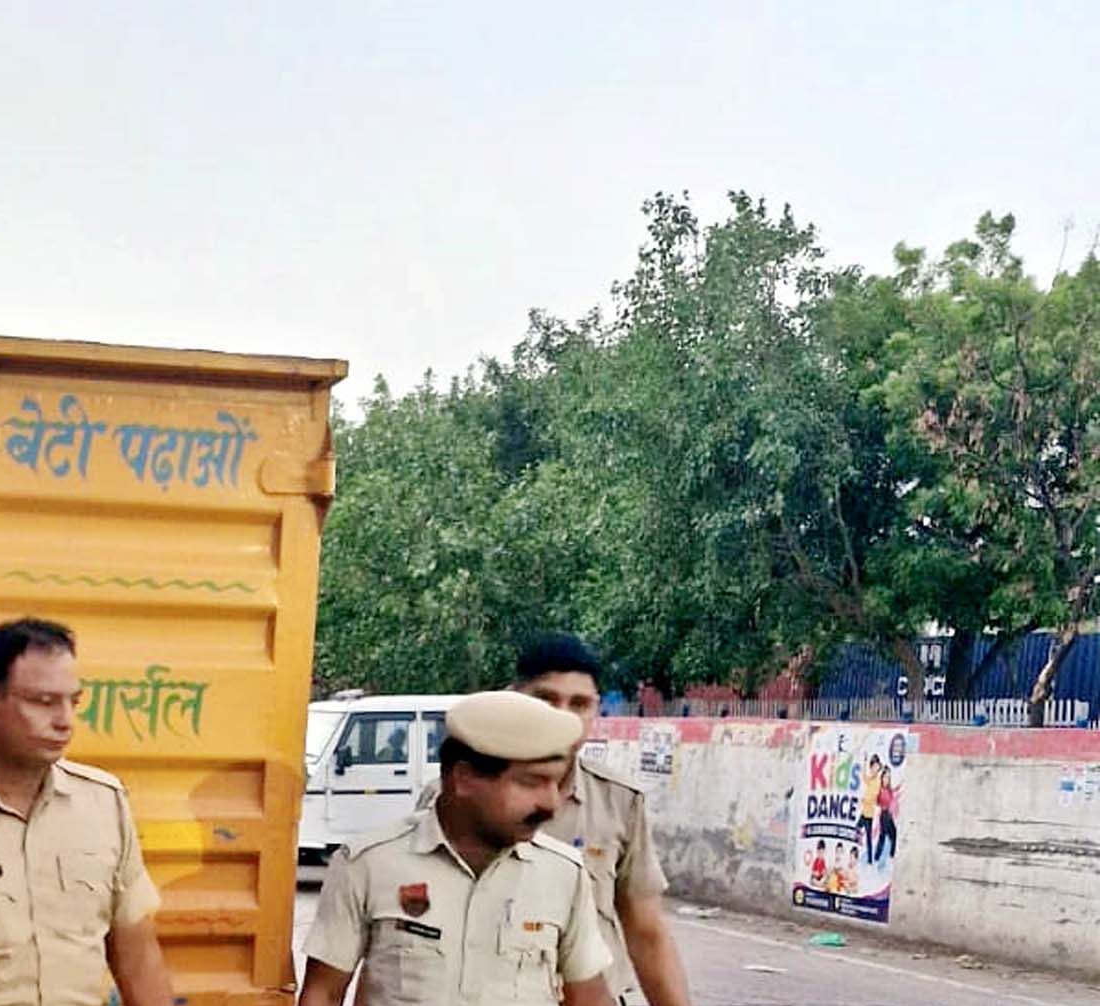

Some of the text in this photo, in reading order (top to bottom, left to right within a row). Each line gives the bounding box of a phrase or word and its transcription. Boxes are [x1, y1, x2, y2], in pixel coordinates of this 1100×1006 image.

[4, 394, 107, 479] बेटी
[810, 752, 860, 791] Kids
[807, 795, 859, 821] DANCE
